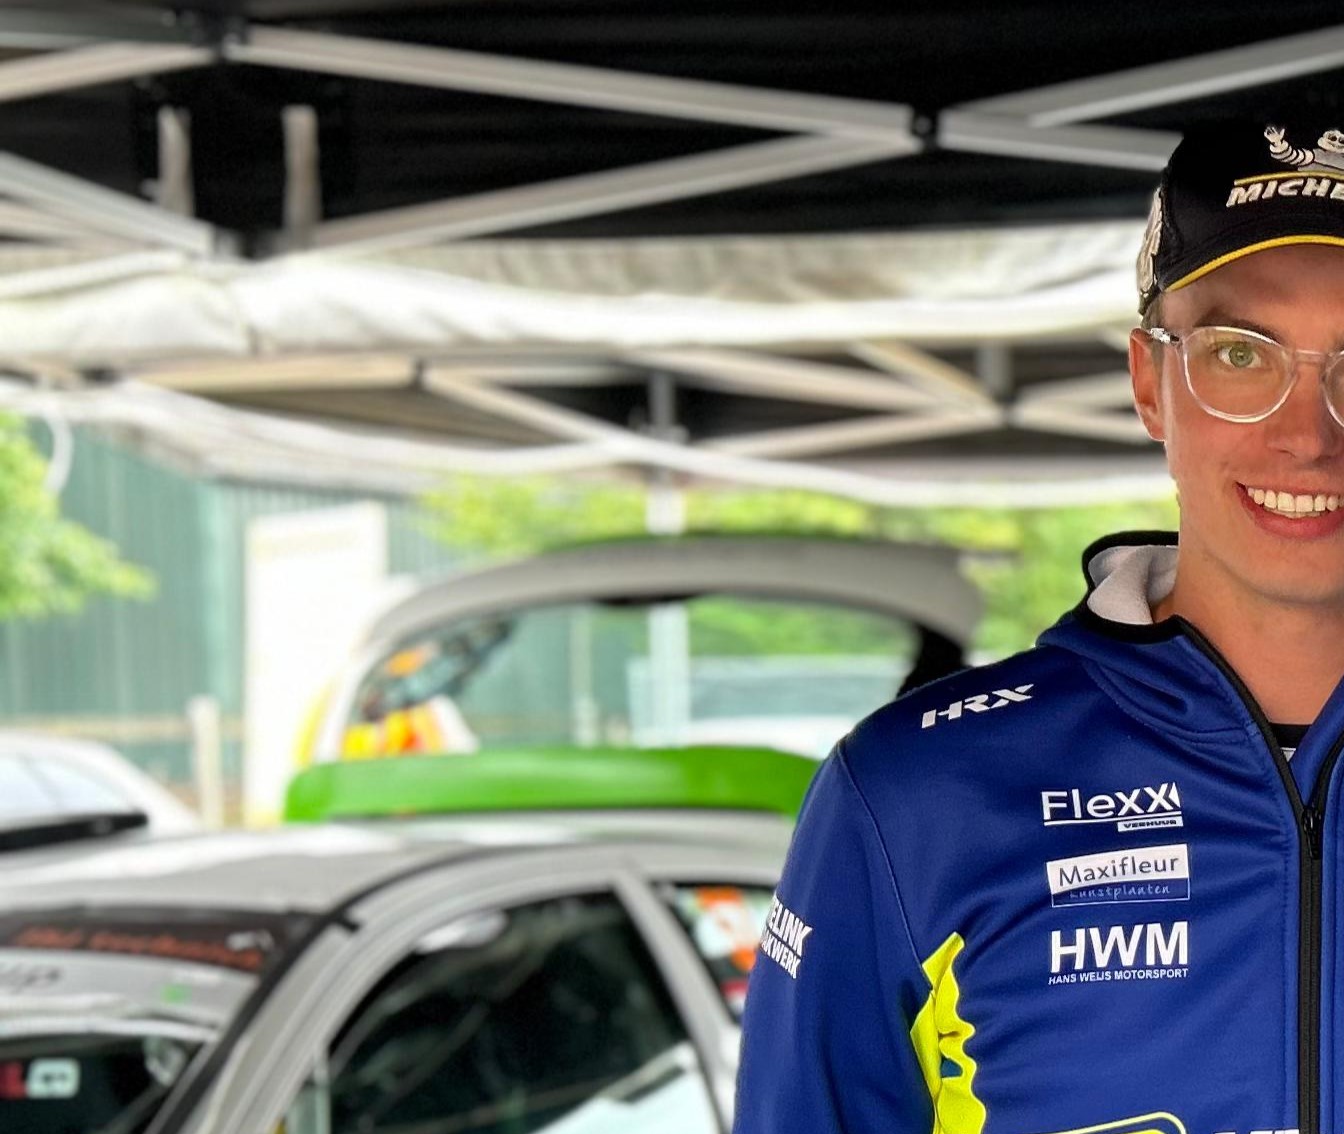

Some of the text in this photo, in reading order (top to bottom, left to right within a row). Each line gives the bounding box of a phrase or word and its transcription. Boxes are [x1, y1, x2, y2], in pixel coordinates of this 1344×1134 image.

[921, 684, 1035, 729] HRX
[1059, 855, 1179, 887] Maxifleur
[1051, 921, 1188, 973] HWM
[1048, 973, 1077, 985] HANS
[1114, 968, 1189, 981] MOTORSPORT
